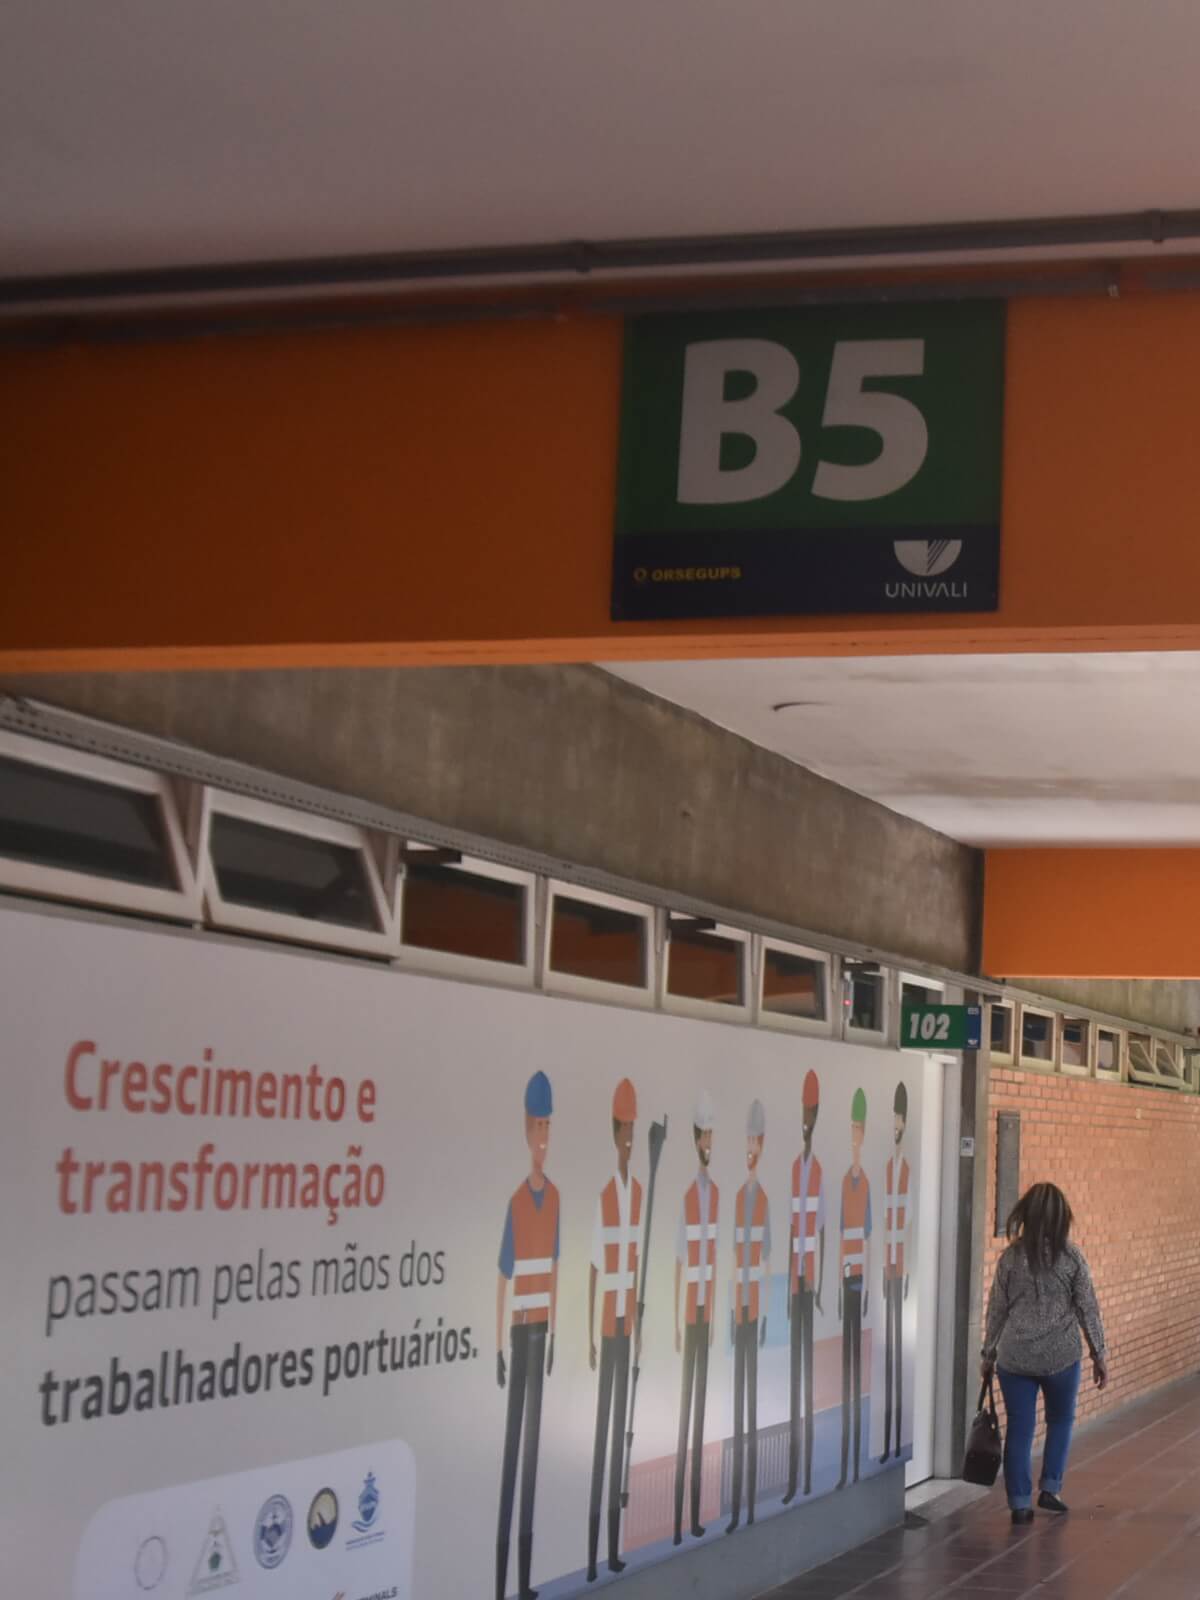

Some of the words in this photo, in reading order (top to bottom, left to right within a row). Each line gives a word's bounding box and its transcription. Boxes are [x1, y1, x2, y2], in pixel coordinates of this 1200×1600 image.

[677, 338, 928, 504] B5
[651, 566, 741, 582] ORSEGUPS
[885, 582, 968, 598] UNIVALI
[909, 1012, 950, 1040] 102
[63, 1040, 346, 1123] Crescimento
[357, 1078, 377, 1123] e
[56, 1143, 385, 1227] transformação
[45, 1261, 200, 1337] passam
[212, 1248, 302, 1319] pelas
[311, 1242, 391, 1297] mãos
[399, 1239, 446, 1287] dos
[39, 1342, 315, 1427] trabalhadores
[322, 1317, 479, 1397] portuários.
